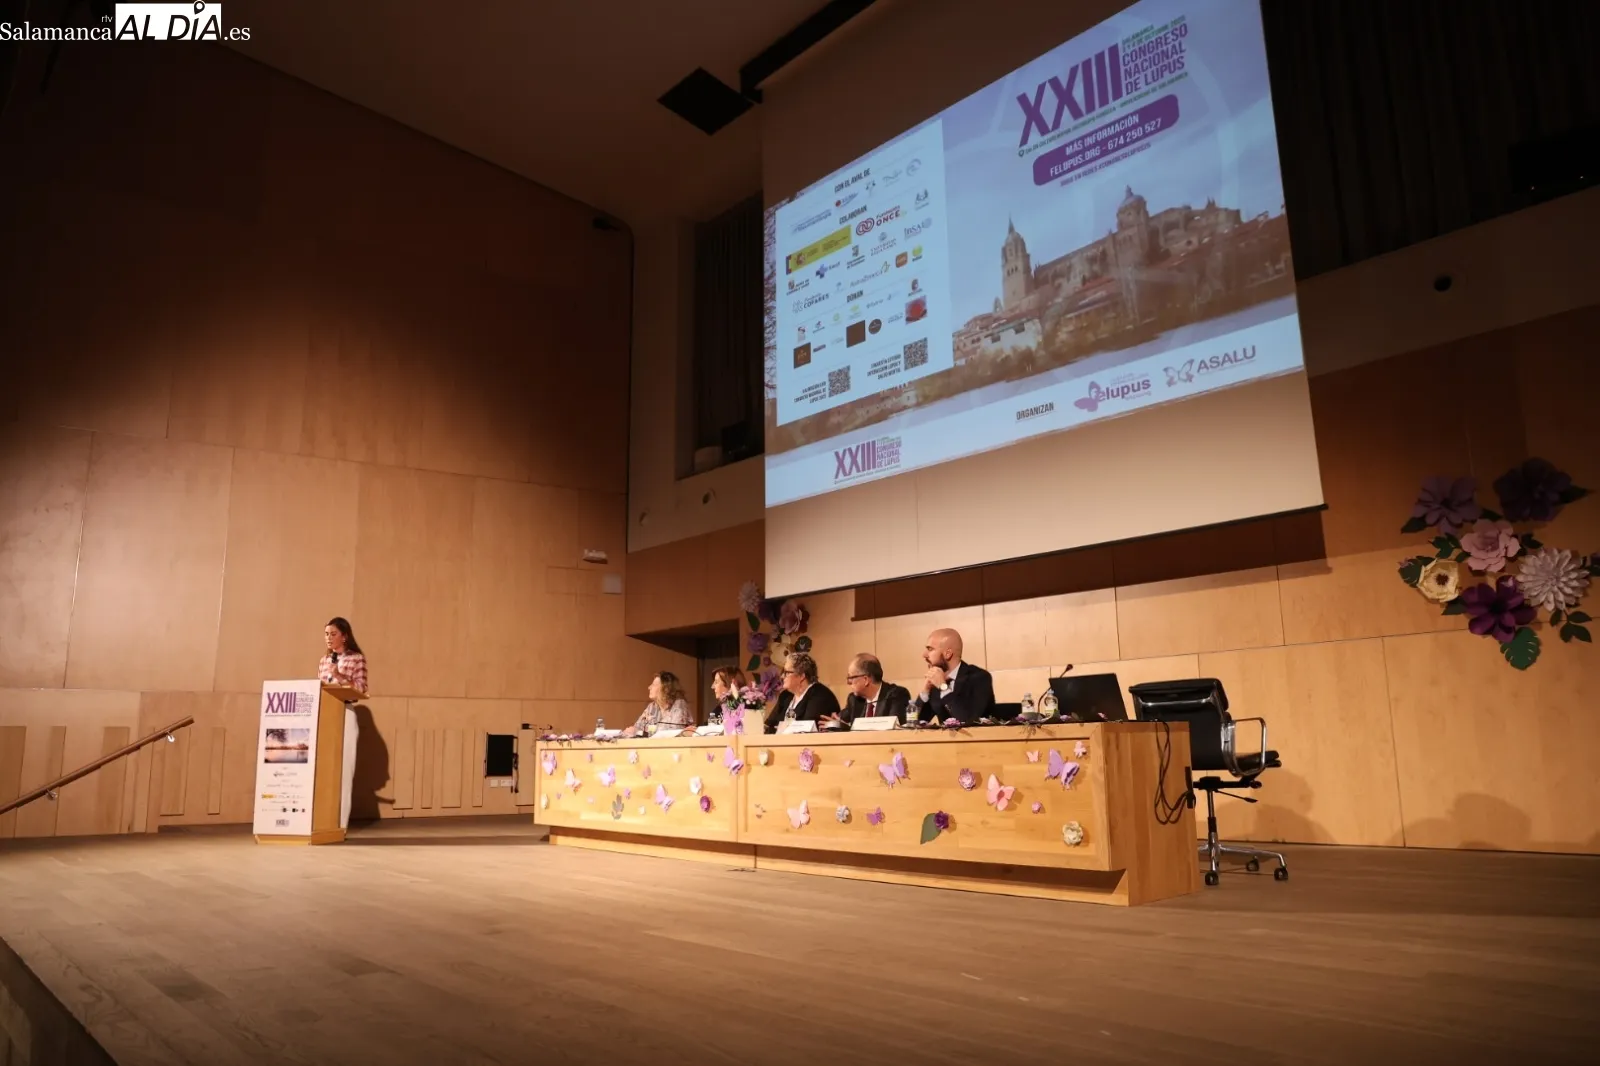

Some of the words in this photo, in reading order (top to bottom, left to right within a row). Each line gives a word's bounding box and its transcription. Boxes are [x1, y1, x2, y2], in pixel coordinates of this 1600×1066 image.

[1122, 23, 1188, 67] CONGRESO
[1124, 41, 1187, 81] NACIONAL
[1016, 43, 1124, 148] XXIII
[1125, 78, 1141, 96] DE
[1144, 55, 1185, 86] LUPUS
[1050, 146, 1101, 177] FELUPUS.ORG
[1108, 134, 1125, 151] 674
[1126, 126, 1143, 143] 250
[1145, 118, 1162, 133] 527
[1065, 137, 1083, 156] MÁS
[1084, 113, 1139, 147] INFORMACIÓN
[876, 209, 901, 227] ONCE
[1196, 345, 1257, 374] ASALU
[1016, 401, 1055, 421] ORGANIZAN
[834, 440, 877, 480] XXIII
[265, 692, 297, 713] XXIII
